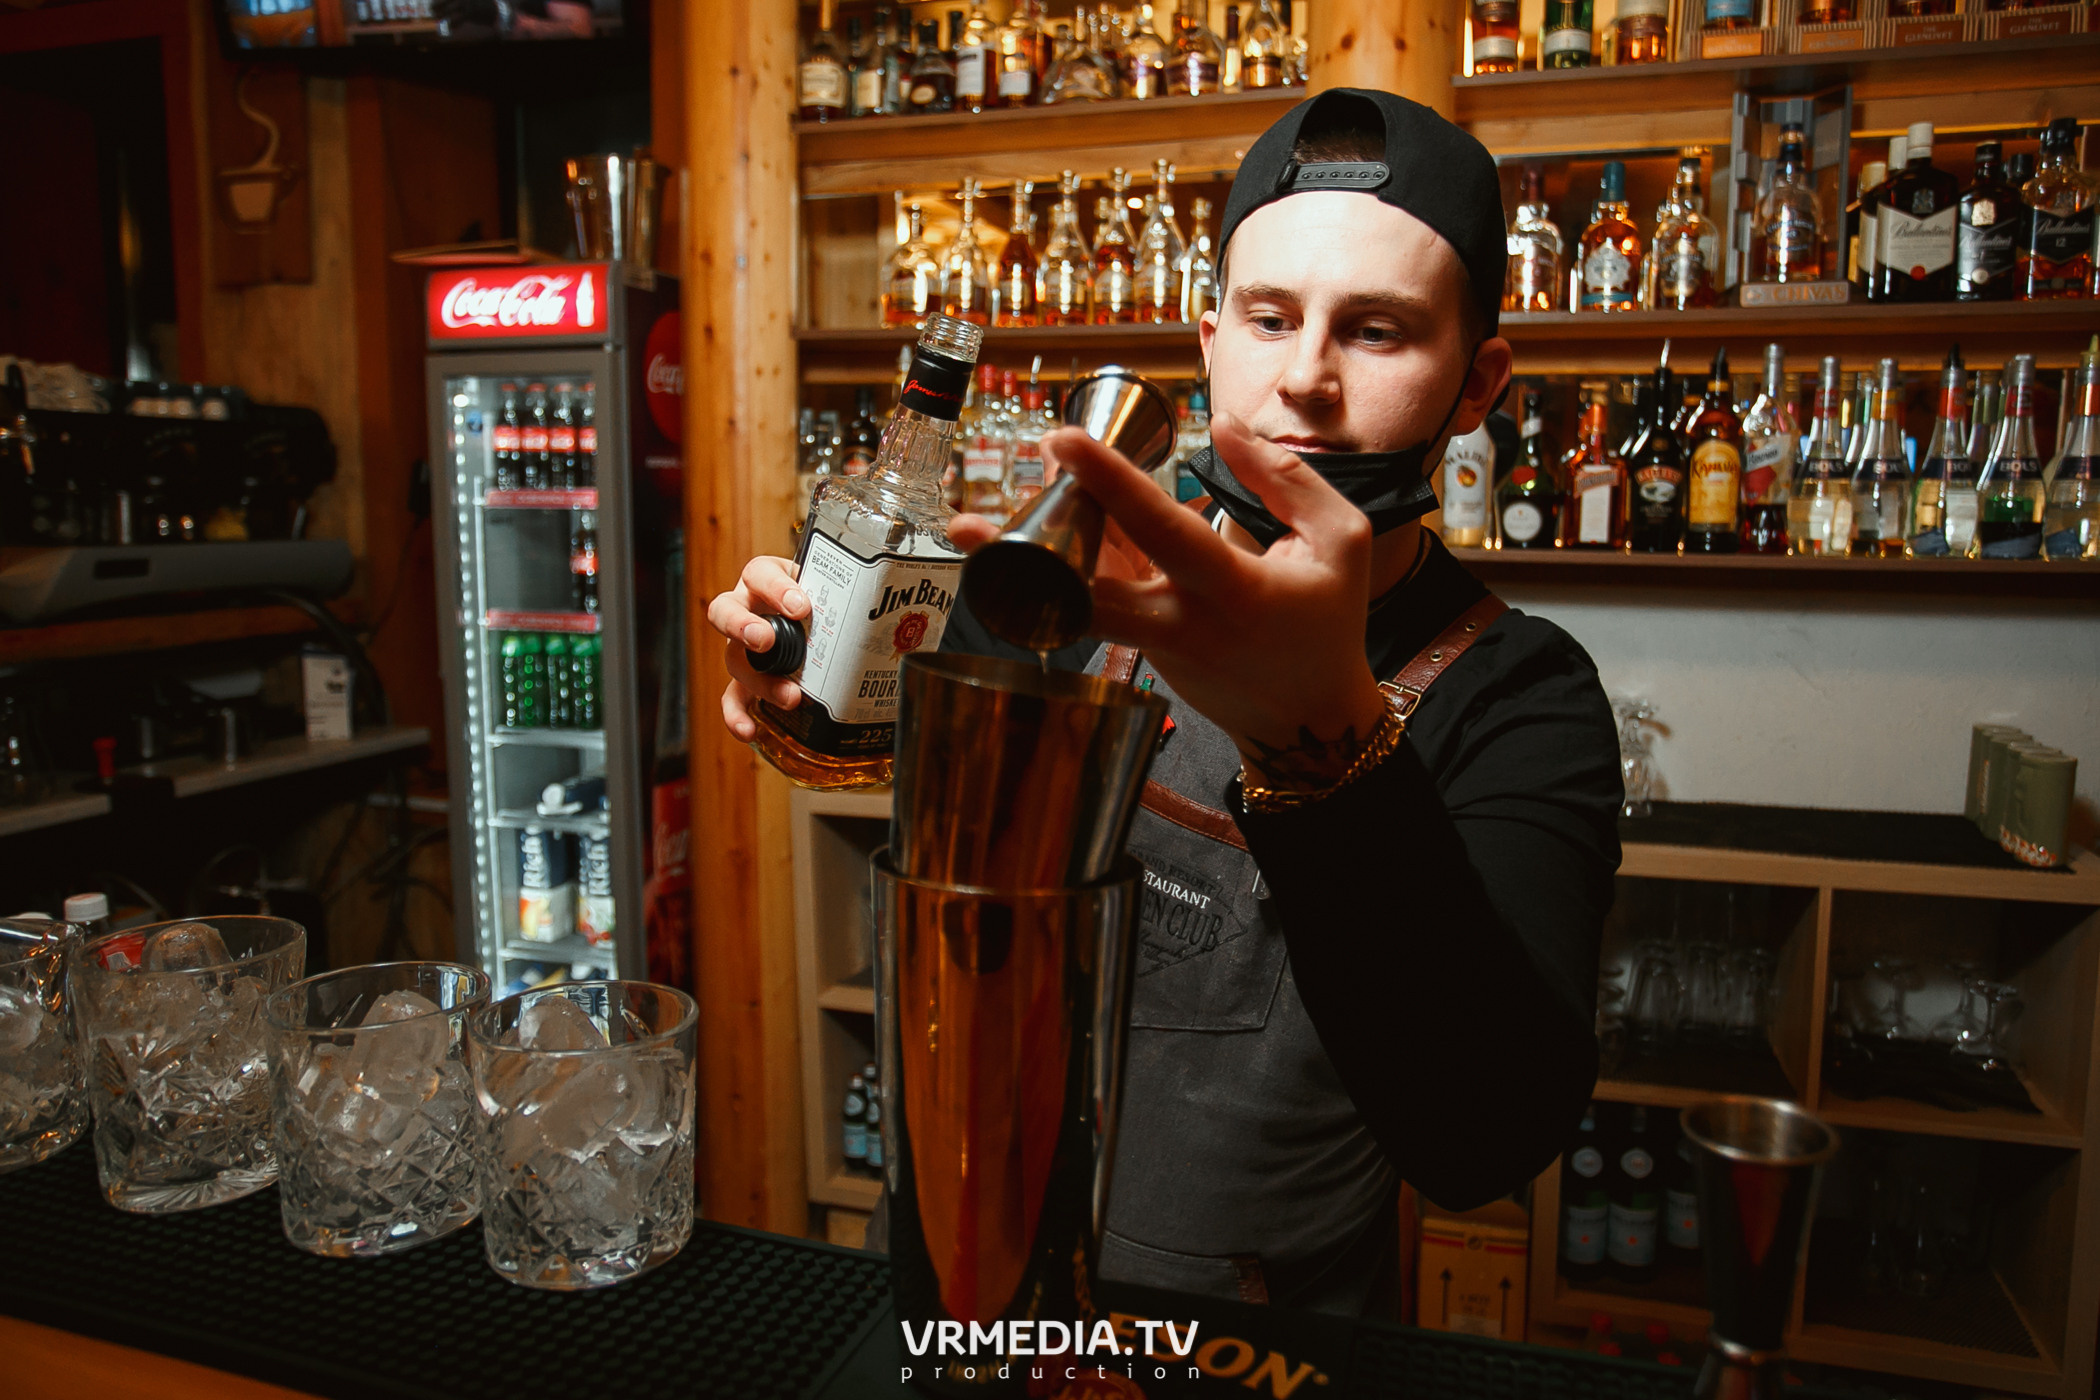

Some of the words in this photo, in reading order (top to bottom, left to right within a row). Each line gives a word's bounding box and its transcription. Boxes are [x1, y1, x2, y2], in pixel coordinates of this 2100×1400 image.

[441, 274, 573, 329] Coca-Cola
[1773, 285, 1845, 300] CHIVAS
[2000, 461, 2037, 472] BOLS
[812, 555, 829, 570] BEAM
[829, 567, 852, 586] FAMILY
[868, 585, 916, 621] JIM
[913, 579, 955, 620] BEAM
[864, 670, 898, 679] KENTUCKY
[858, 680, 899, 698] BOUR
[874, 699, 898, 708] WHISKE
[859, 727, 893, 744] 225
[522, 836, 547, 889] Rich
[587, 843, 611, 896] Rich
